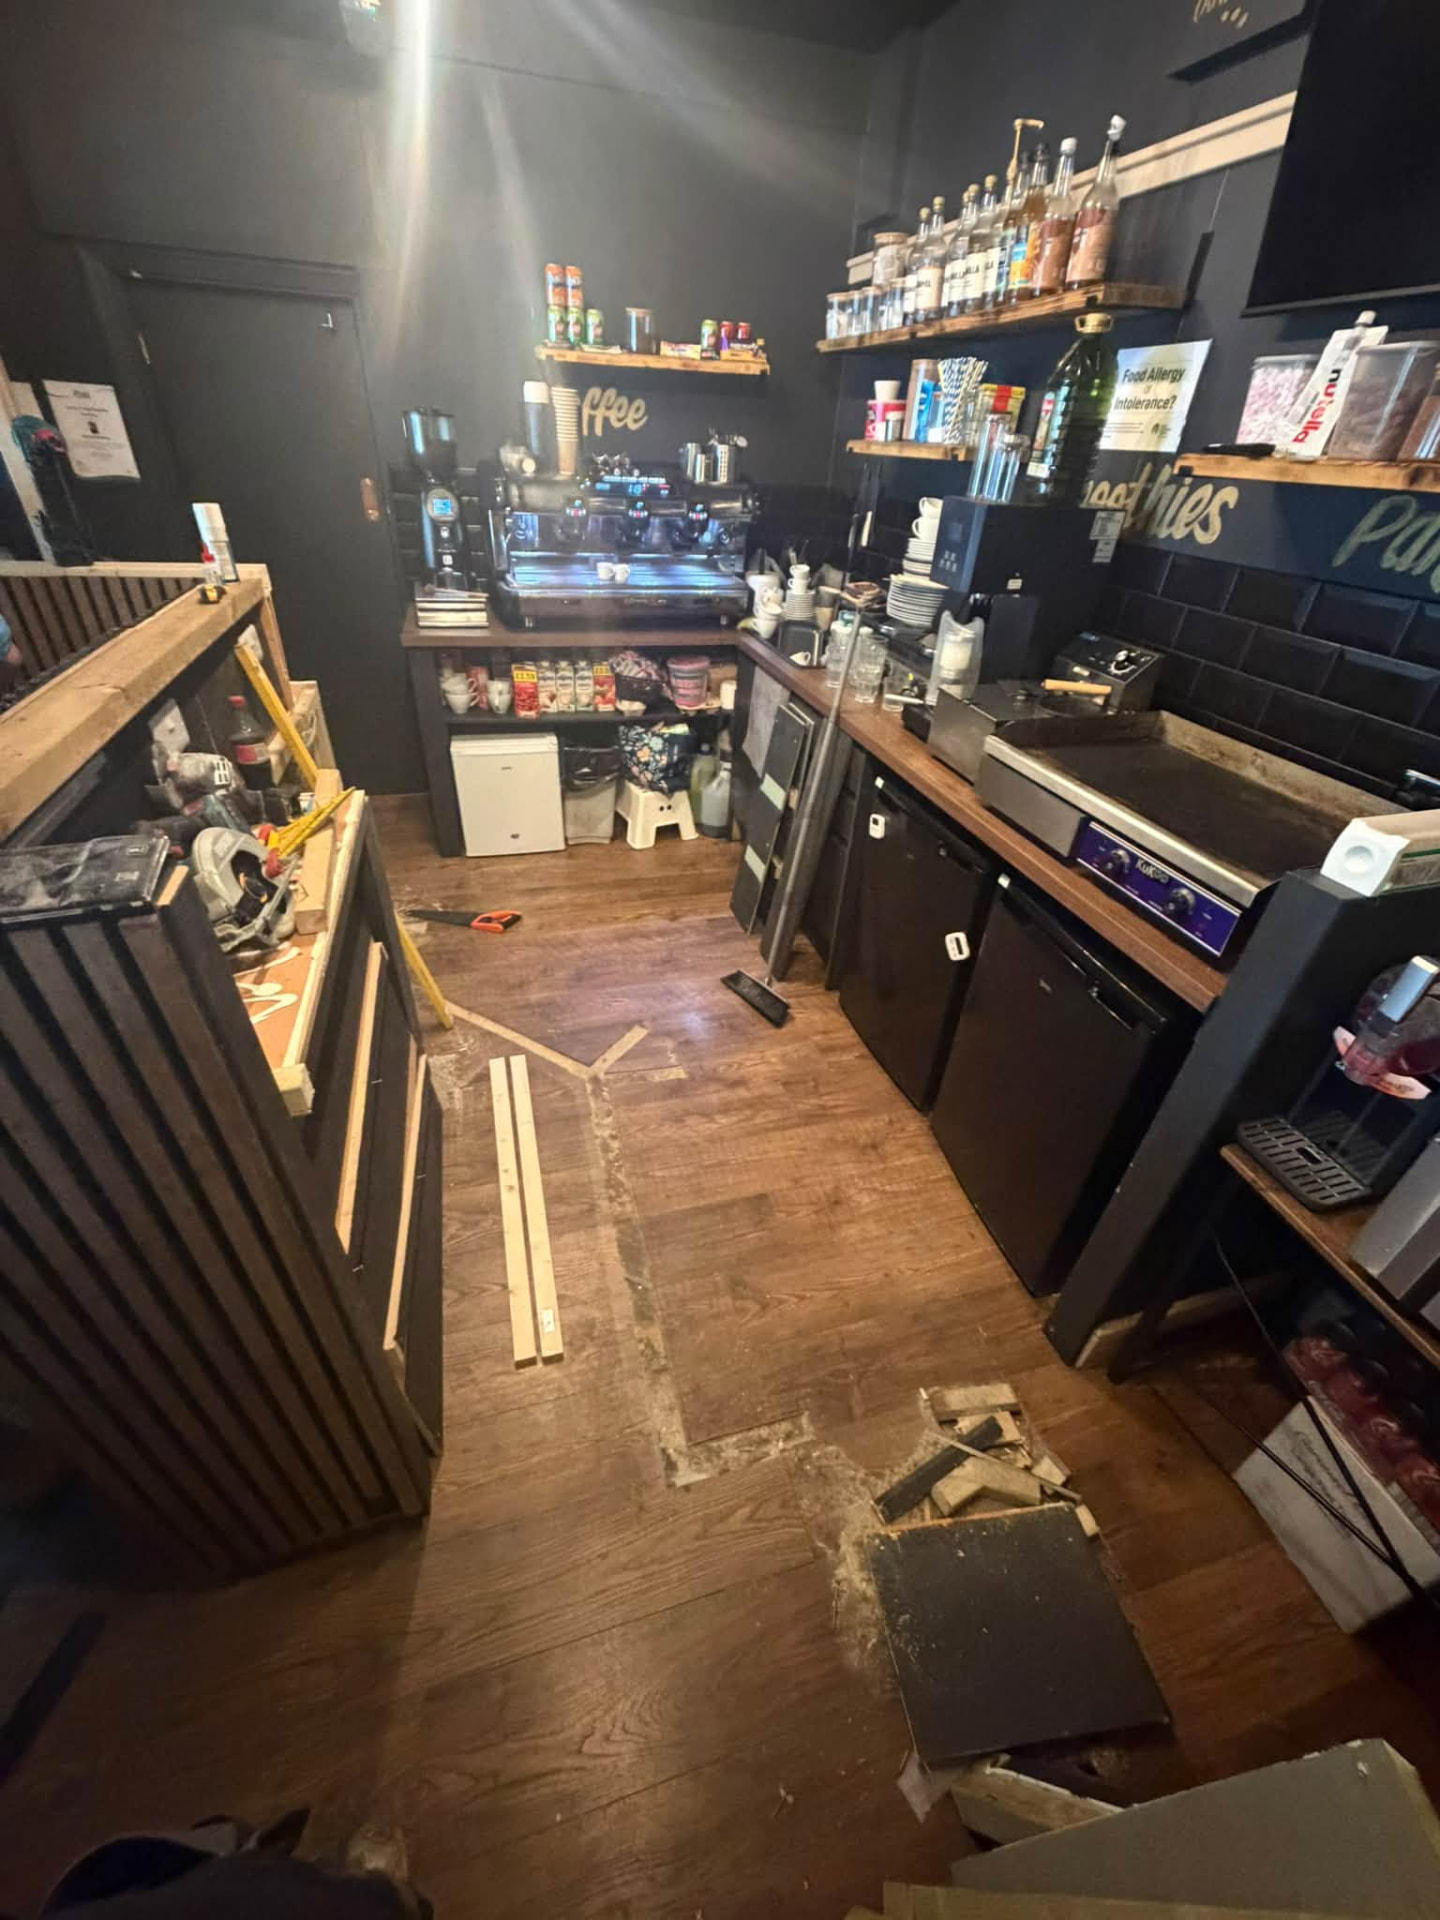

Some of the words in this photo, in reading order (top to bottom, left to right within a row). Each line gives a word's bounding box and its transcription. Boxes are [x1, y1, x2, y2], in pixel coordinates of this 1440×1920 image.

[1122, 368, 1147, 384] Food
[1147, 367, 1186, 384] Allergy
[582, 386, 648, 437] ffee
[1114, 394, 1178, 411] Intolerance?
[1292, 368, 1342, 444] nutella
[1080, 462, 1239, 544] oothies
